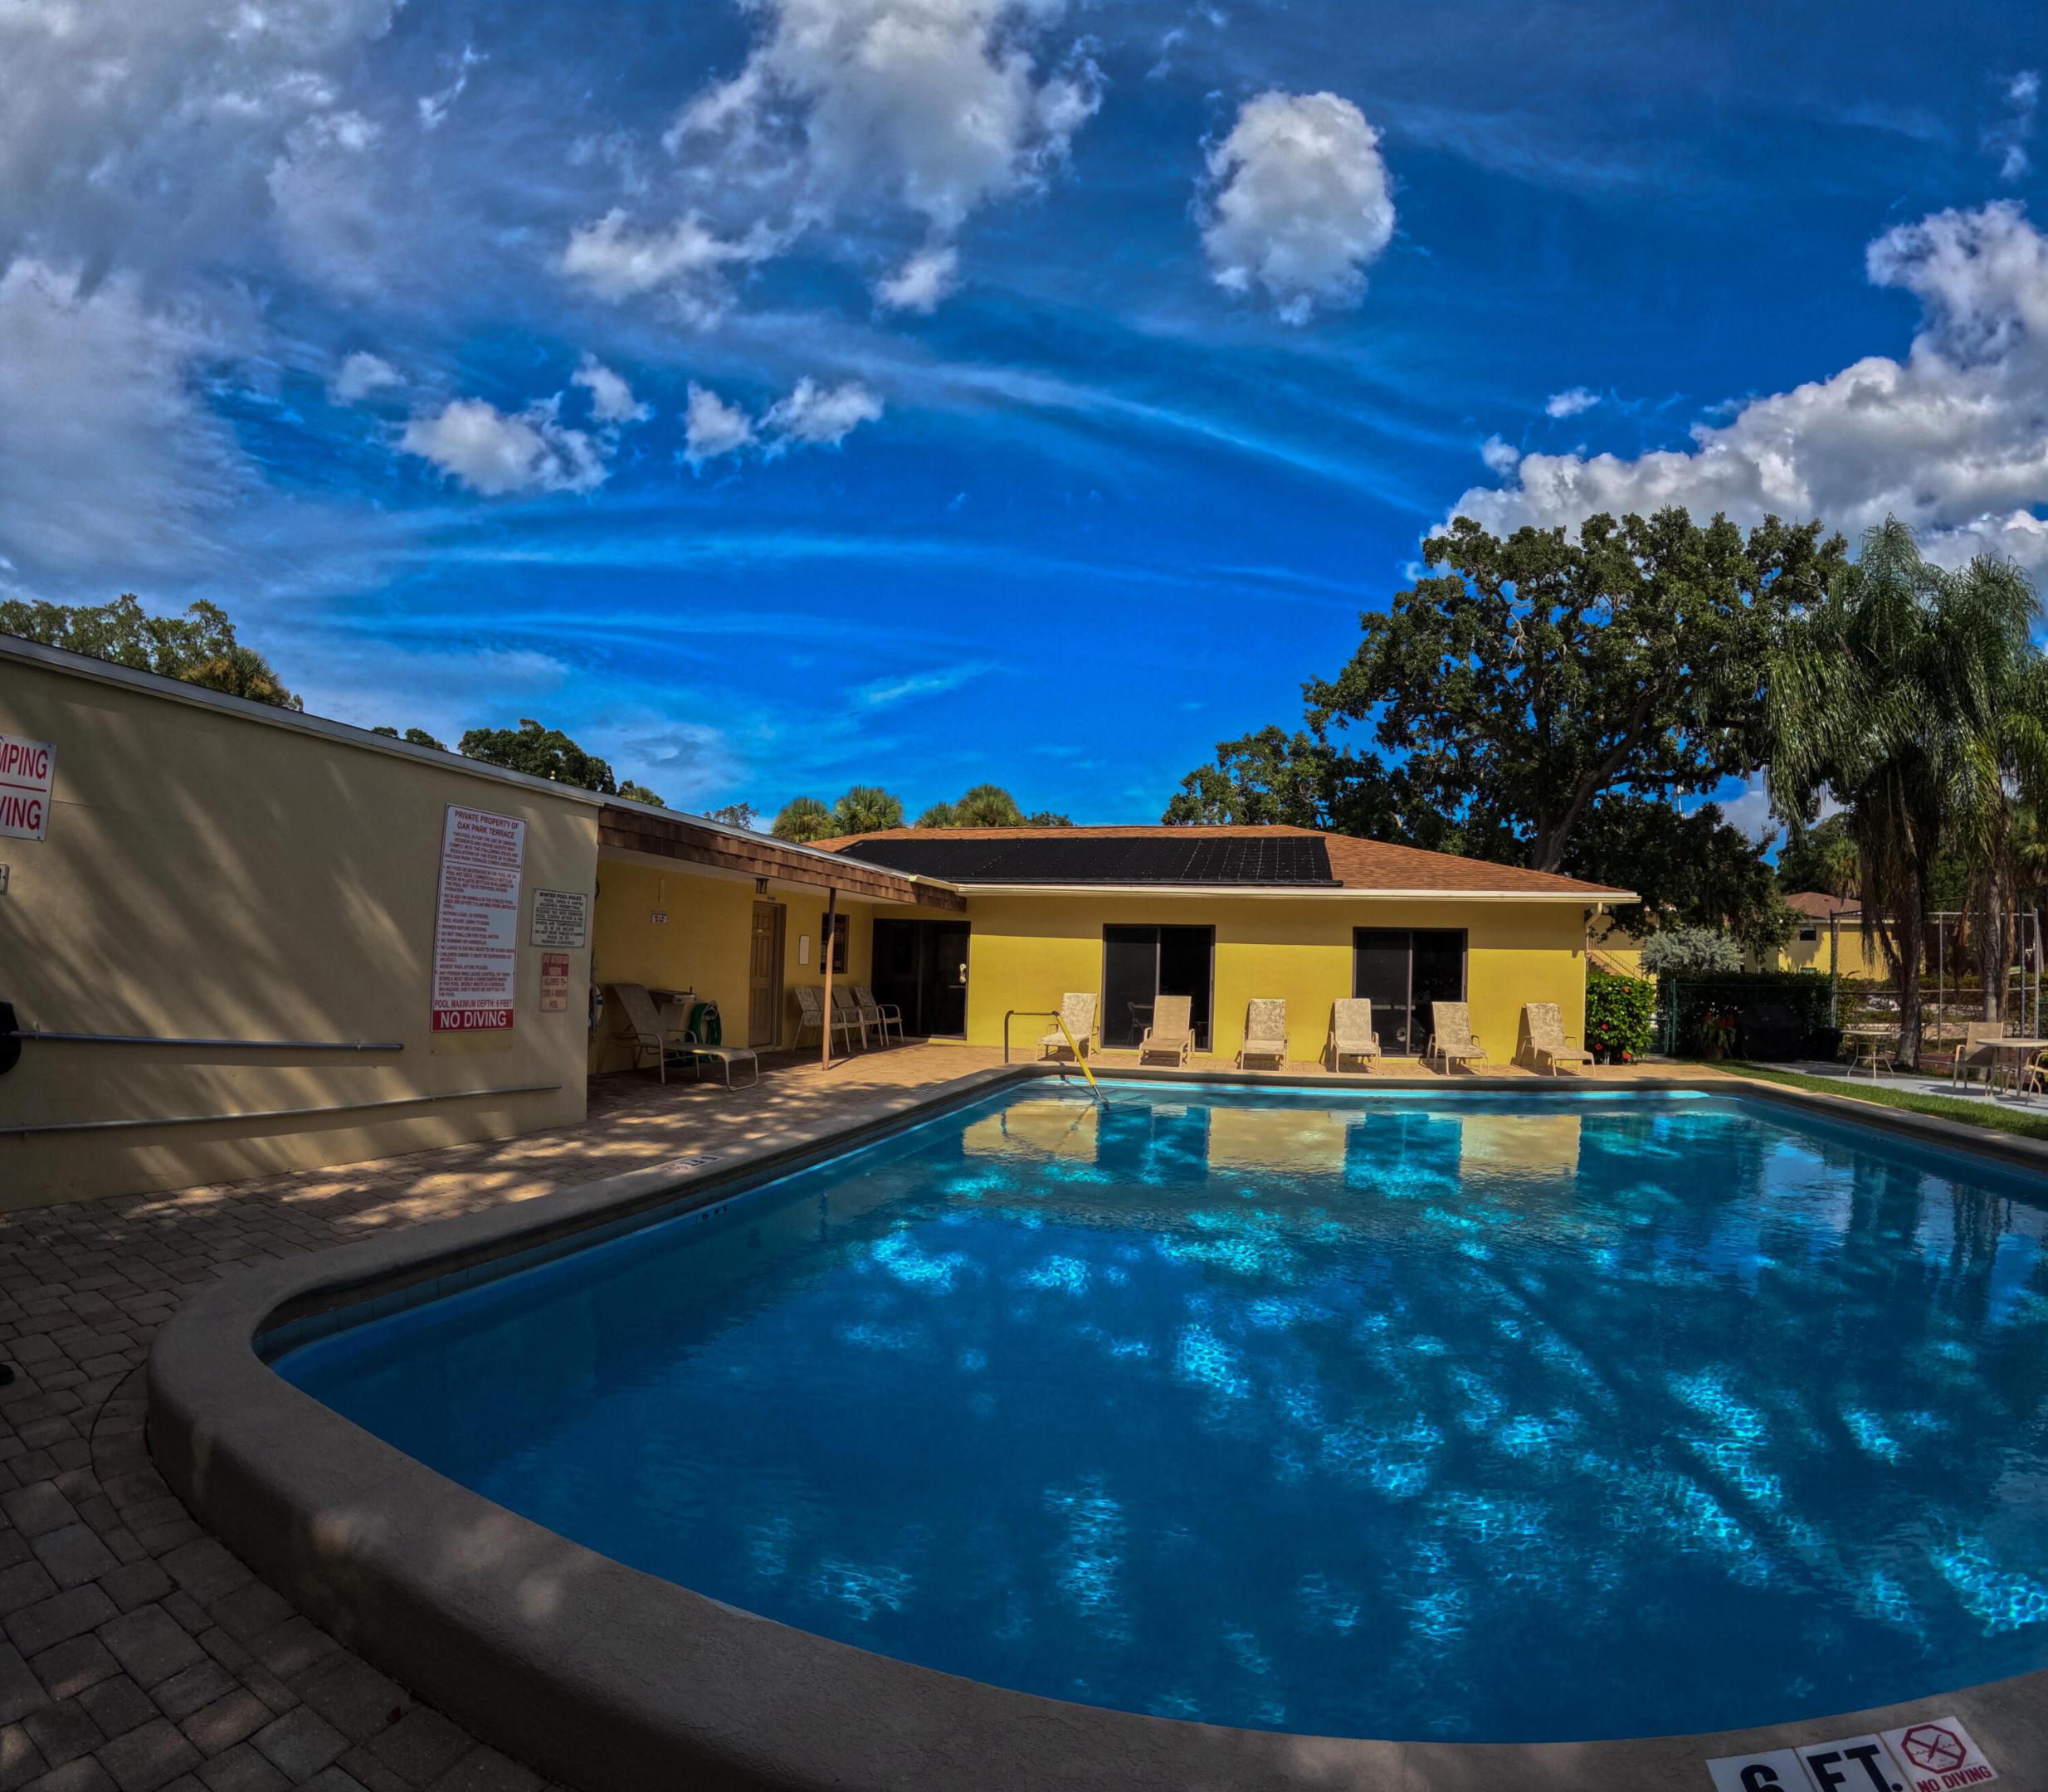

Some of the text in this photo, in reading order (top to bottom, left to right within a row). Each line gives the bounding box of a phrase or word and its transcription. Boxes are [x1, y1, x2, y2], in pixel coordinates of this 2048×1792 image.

[455, 811, 479, 821] PRIVATE
[480, 816, 510, 826] PROPERTY
[456, 821, 514, 838] OAK PARK TERRACE
[434, 1000, 450, 1008] POOL
[451, 999, 476, 1008] MAXIMUM
[476, 999, 495, 1008] DEPTH:
[500, 999, 512, 1008] FEET
[440, 1010, 506, 1028] NO DIVING
[1807, 1744, 1904, 1792] FT.
[1916, 1765, 1992, 1792] NO DIVING
